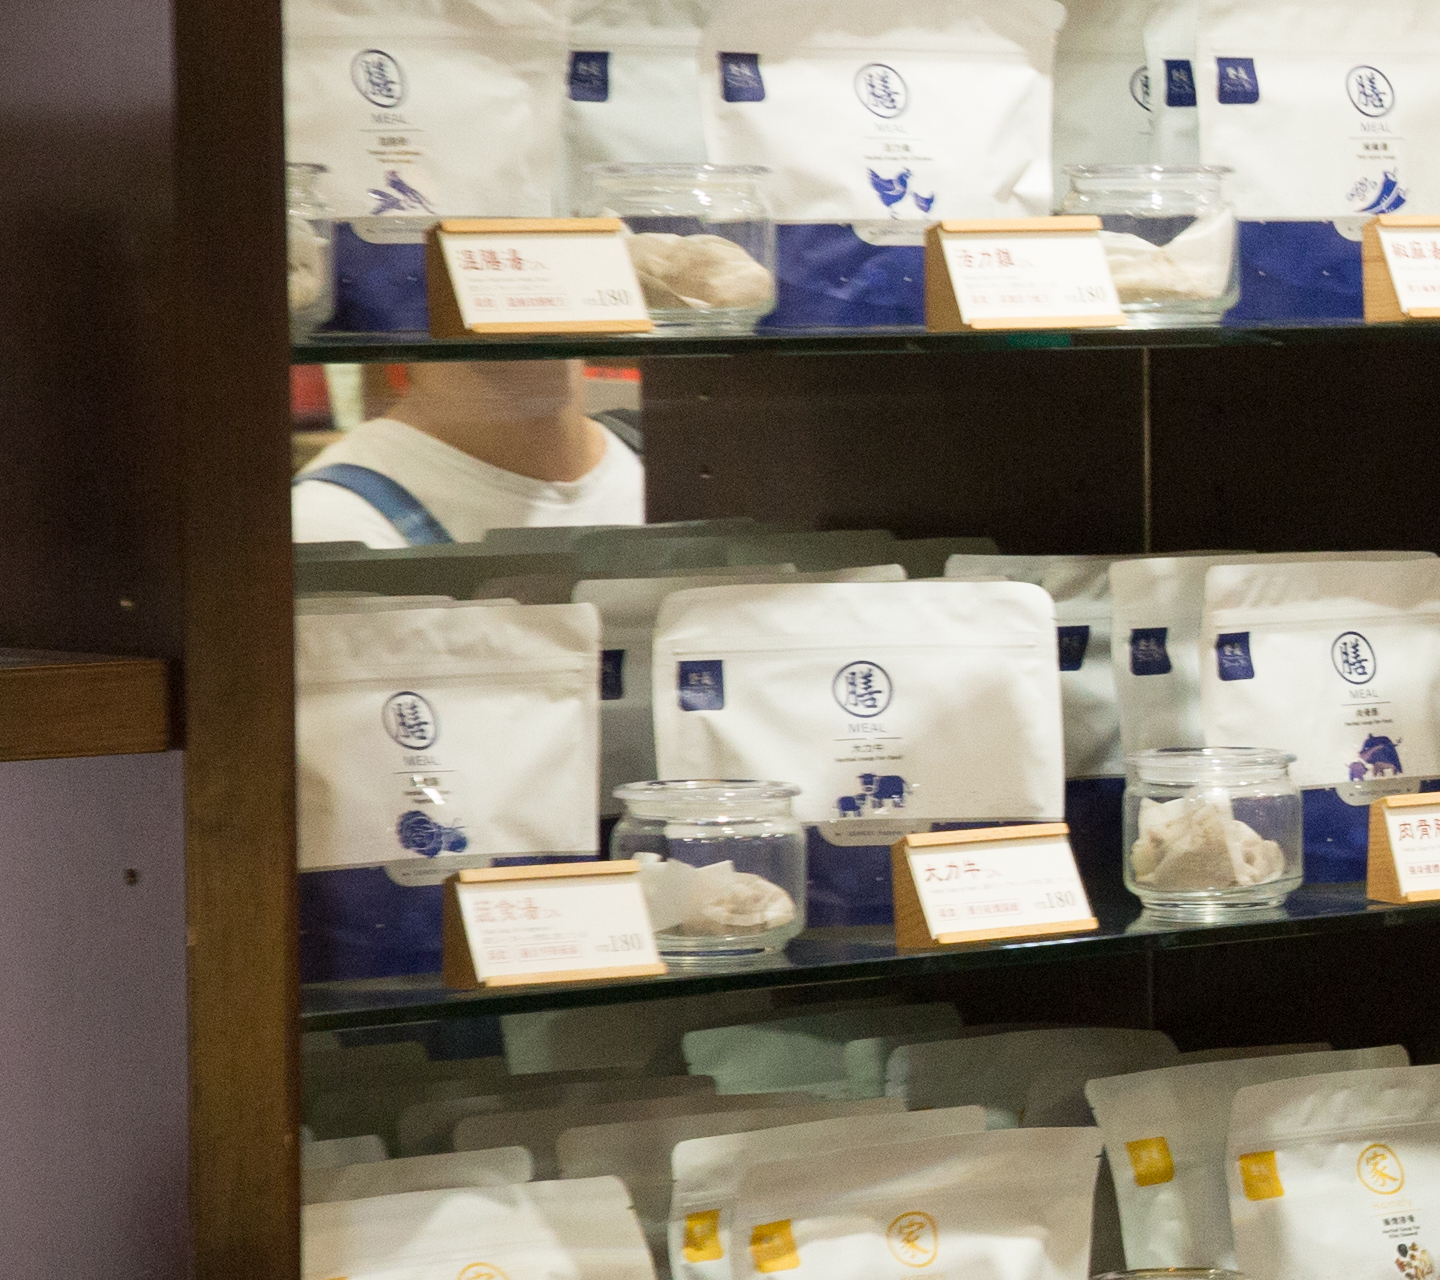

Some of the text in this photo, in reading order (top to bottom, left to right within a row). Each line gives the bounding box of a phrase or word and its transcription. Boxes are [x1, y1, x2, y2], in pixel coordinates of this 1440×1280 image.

[1340, 637, 1370, 678] 膳
[844, 667, 884, 710] 膳
[1349, 688, 1380, 700] MEAL
[847, 723, 887, 733] MEAL
[925, 859, 981, 882] 大力牛
[1367, 1151, 1398, 1189] 家
